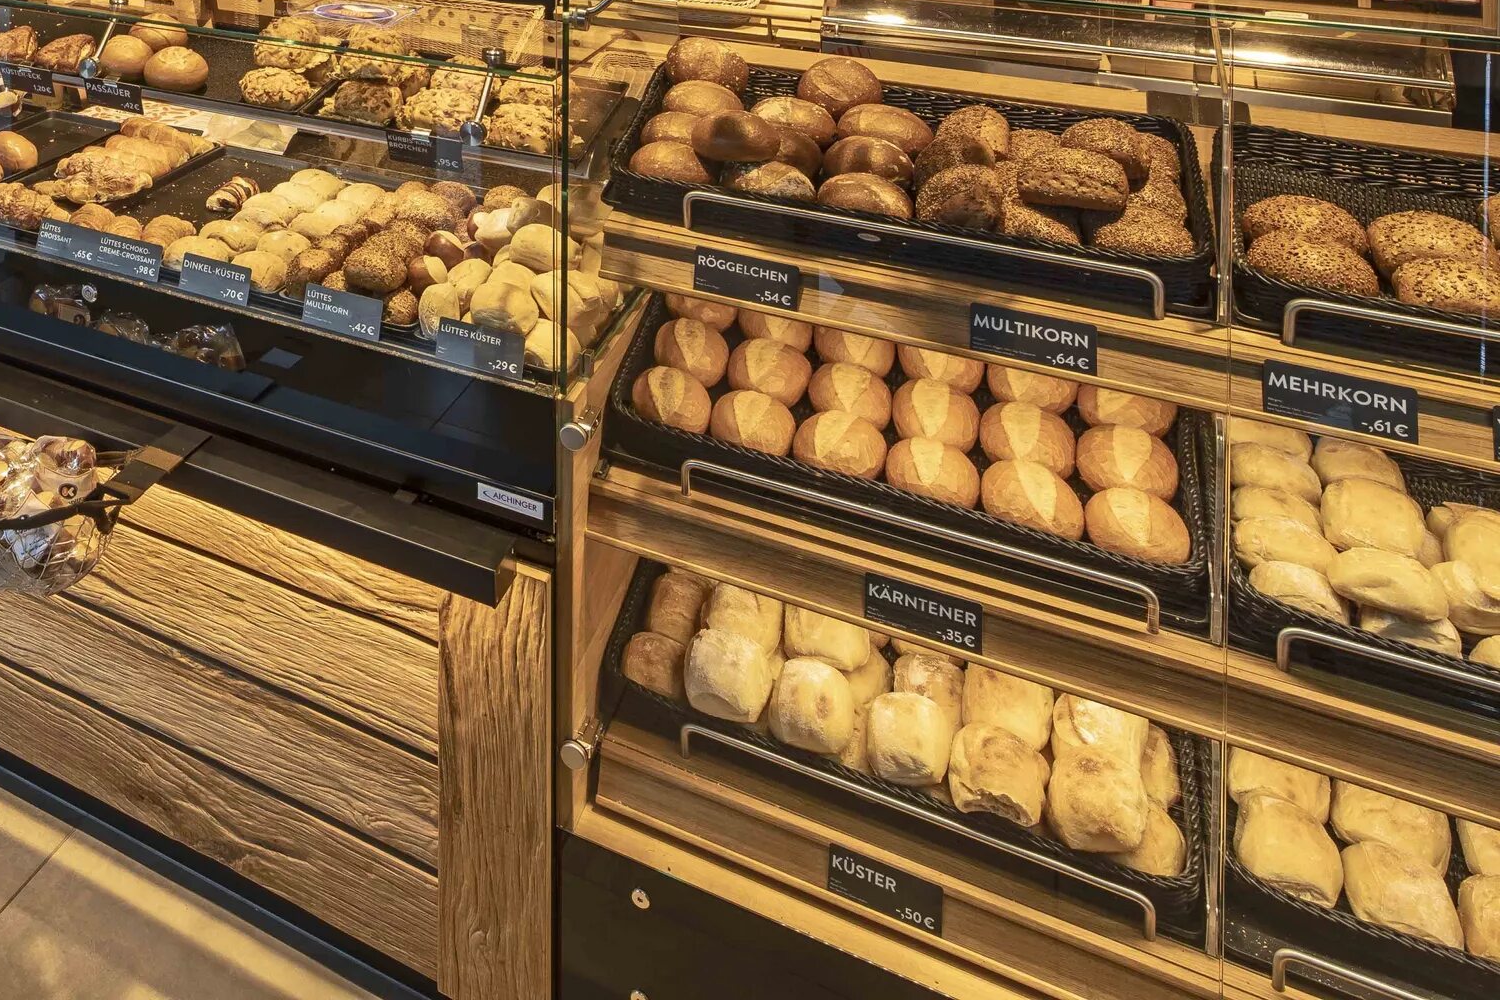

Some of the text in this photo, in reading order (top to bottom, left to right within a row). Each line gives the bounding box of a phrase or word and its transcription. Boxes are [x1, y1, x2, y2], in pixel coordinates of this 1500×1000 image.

[85, 82, 131, 98] PASSAUER
[40, 231, 72, 245] CROISSANT
[41, 222, 62, 233] LÜTTES
[98, 245, 157, 266] CREME-CROISSANT
[100, 236, 151, 255] LÜTTES SCHOKO-
[183, 258, 246, 283] DINKEL-KÜSTER
[696, 254, 789, 285] RÖGGELCHEN
[307, 289, 333, 303] LÜTTES
[305, 299, 350, 317] MULTIKORN
[440, 323, 502, 347] LÜTTES KÜSTER
[973, 312, 1089, 350] MULTIKORN
[1267, 371, 1408, 415] MEHRKORN
[492, 491, 538, 512] AICHINGER
[868, 582, 977, 628] KÄRNTENER
[832, 853, 897, 893] KÜSTER
